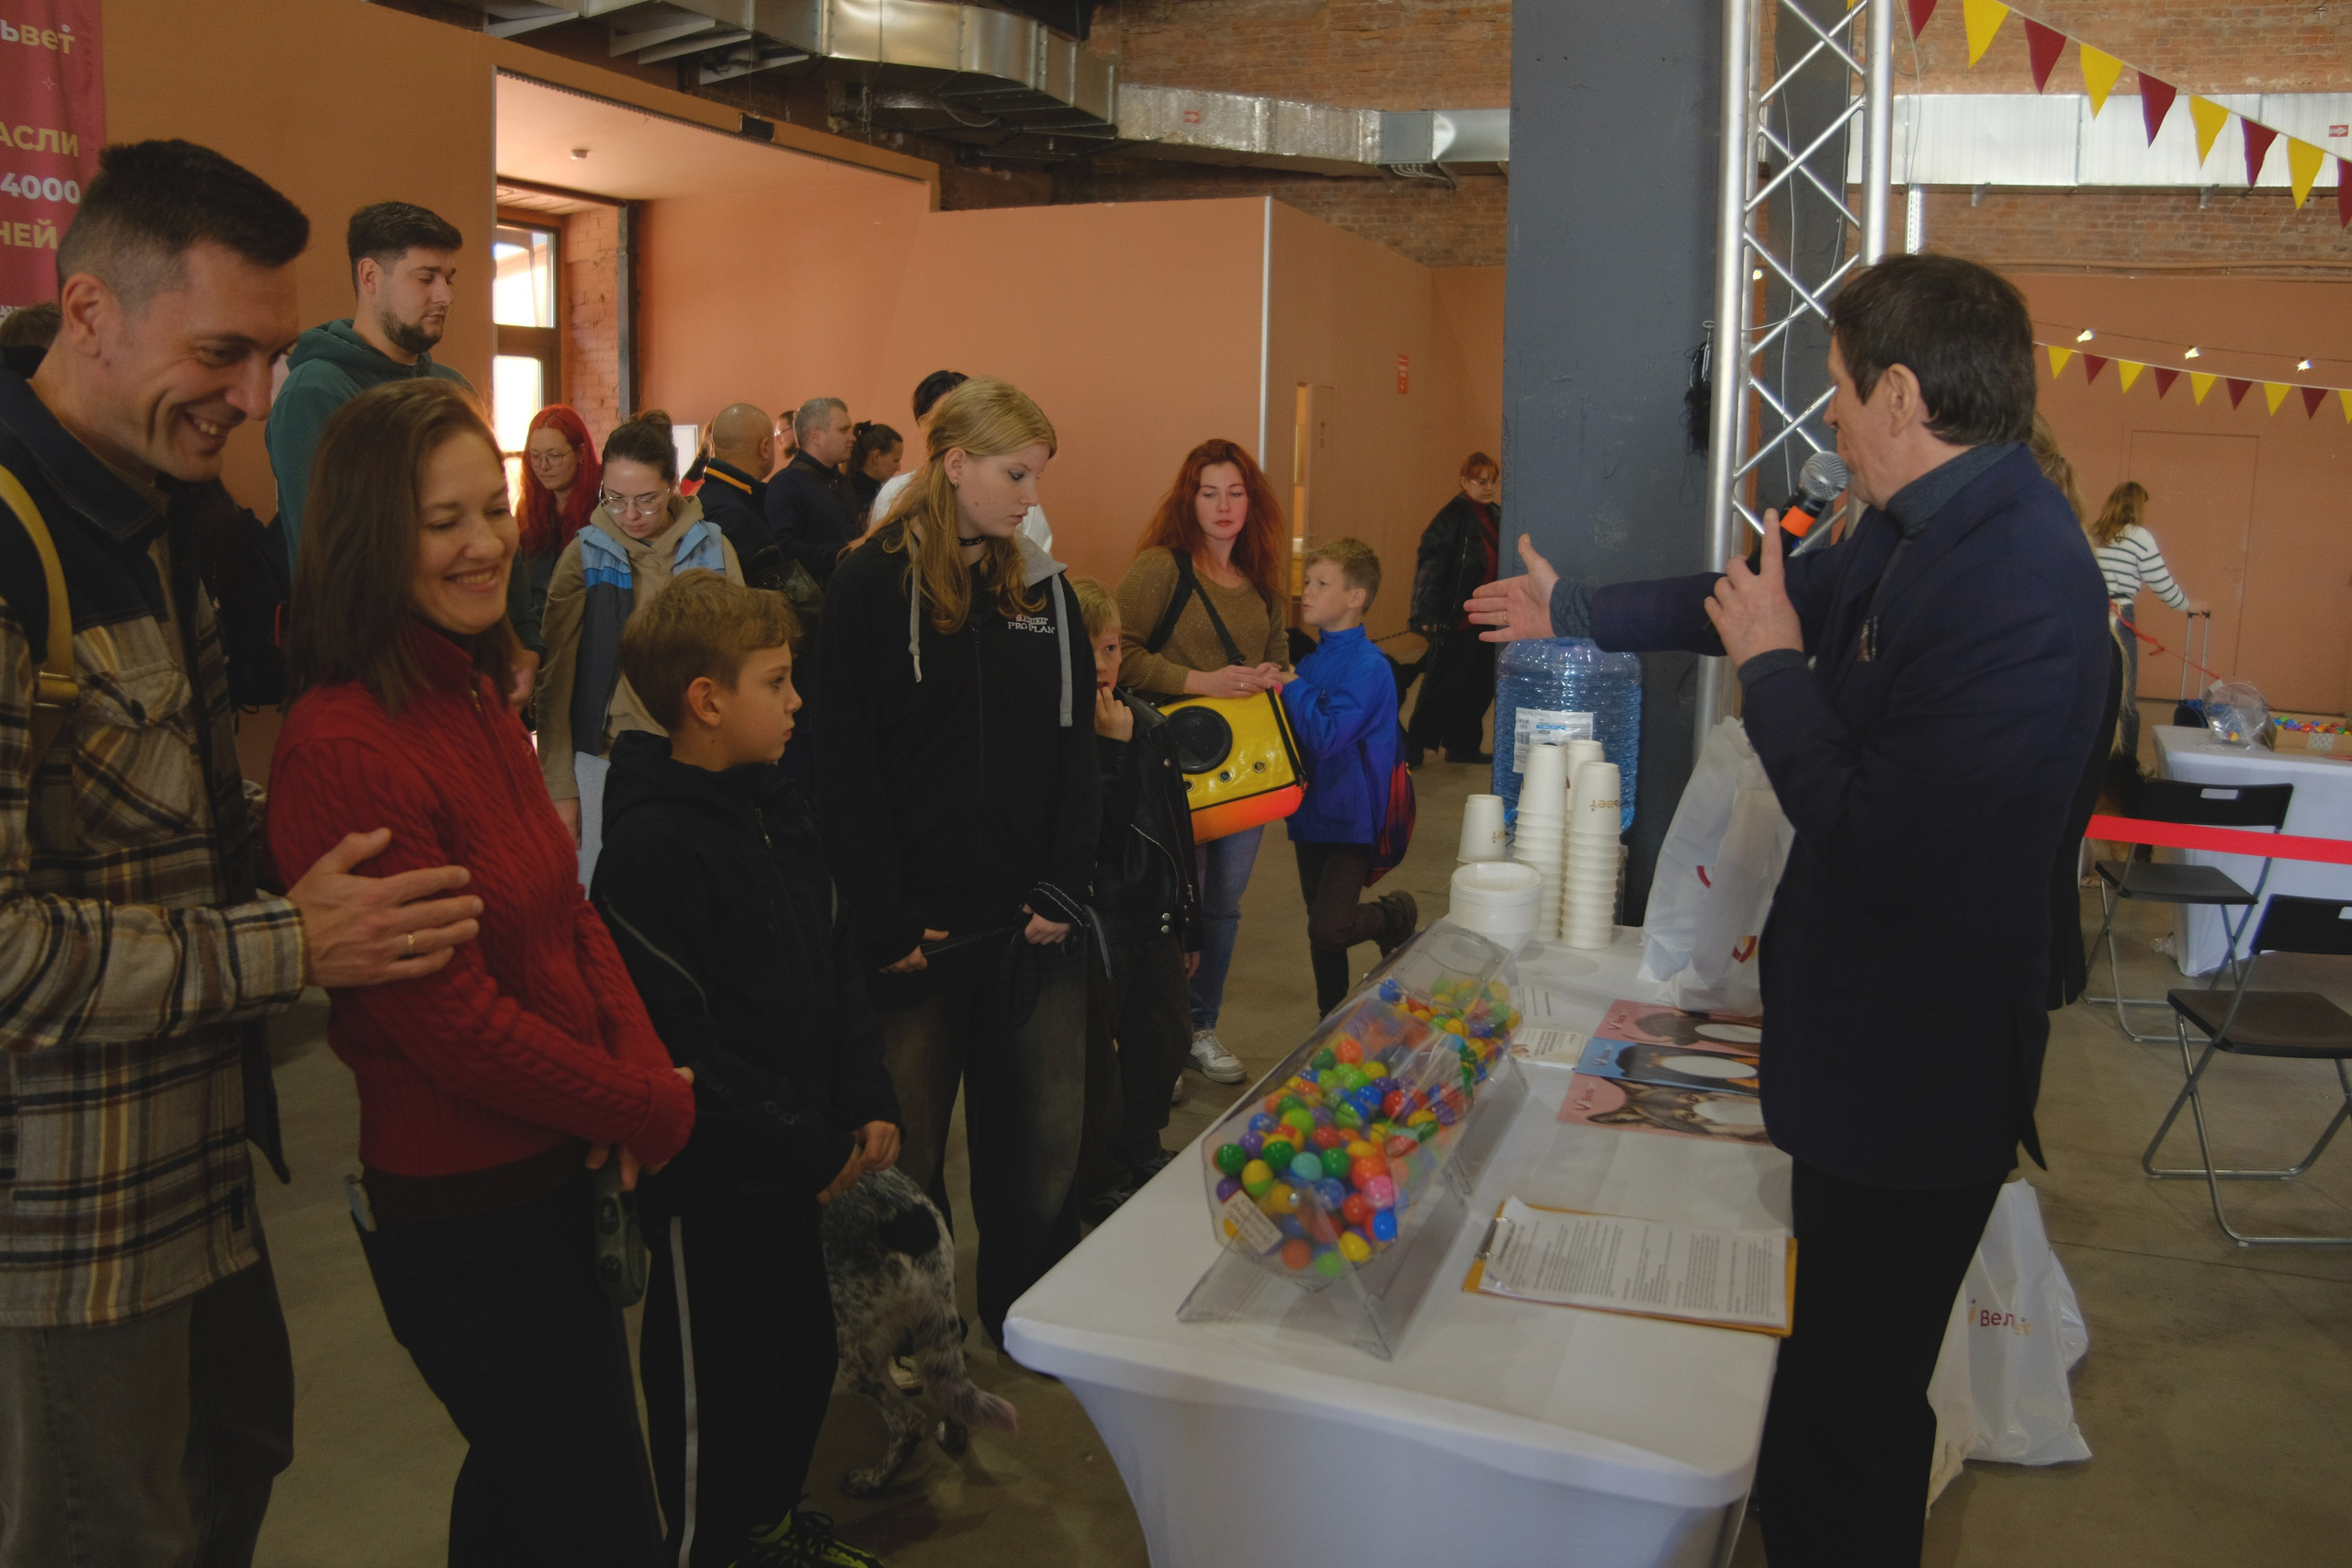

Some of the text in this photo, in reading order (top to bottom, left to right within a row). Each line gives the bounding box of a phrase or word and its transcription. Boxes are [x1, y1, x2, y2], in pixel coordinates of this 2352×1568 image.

[0, 172, 82, 205] 4000
[1007, 621, 1055, 634] PRO PLAN
